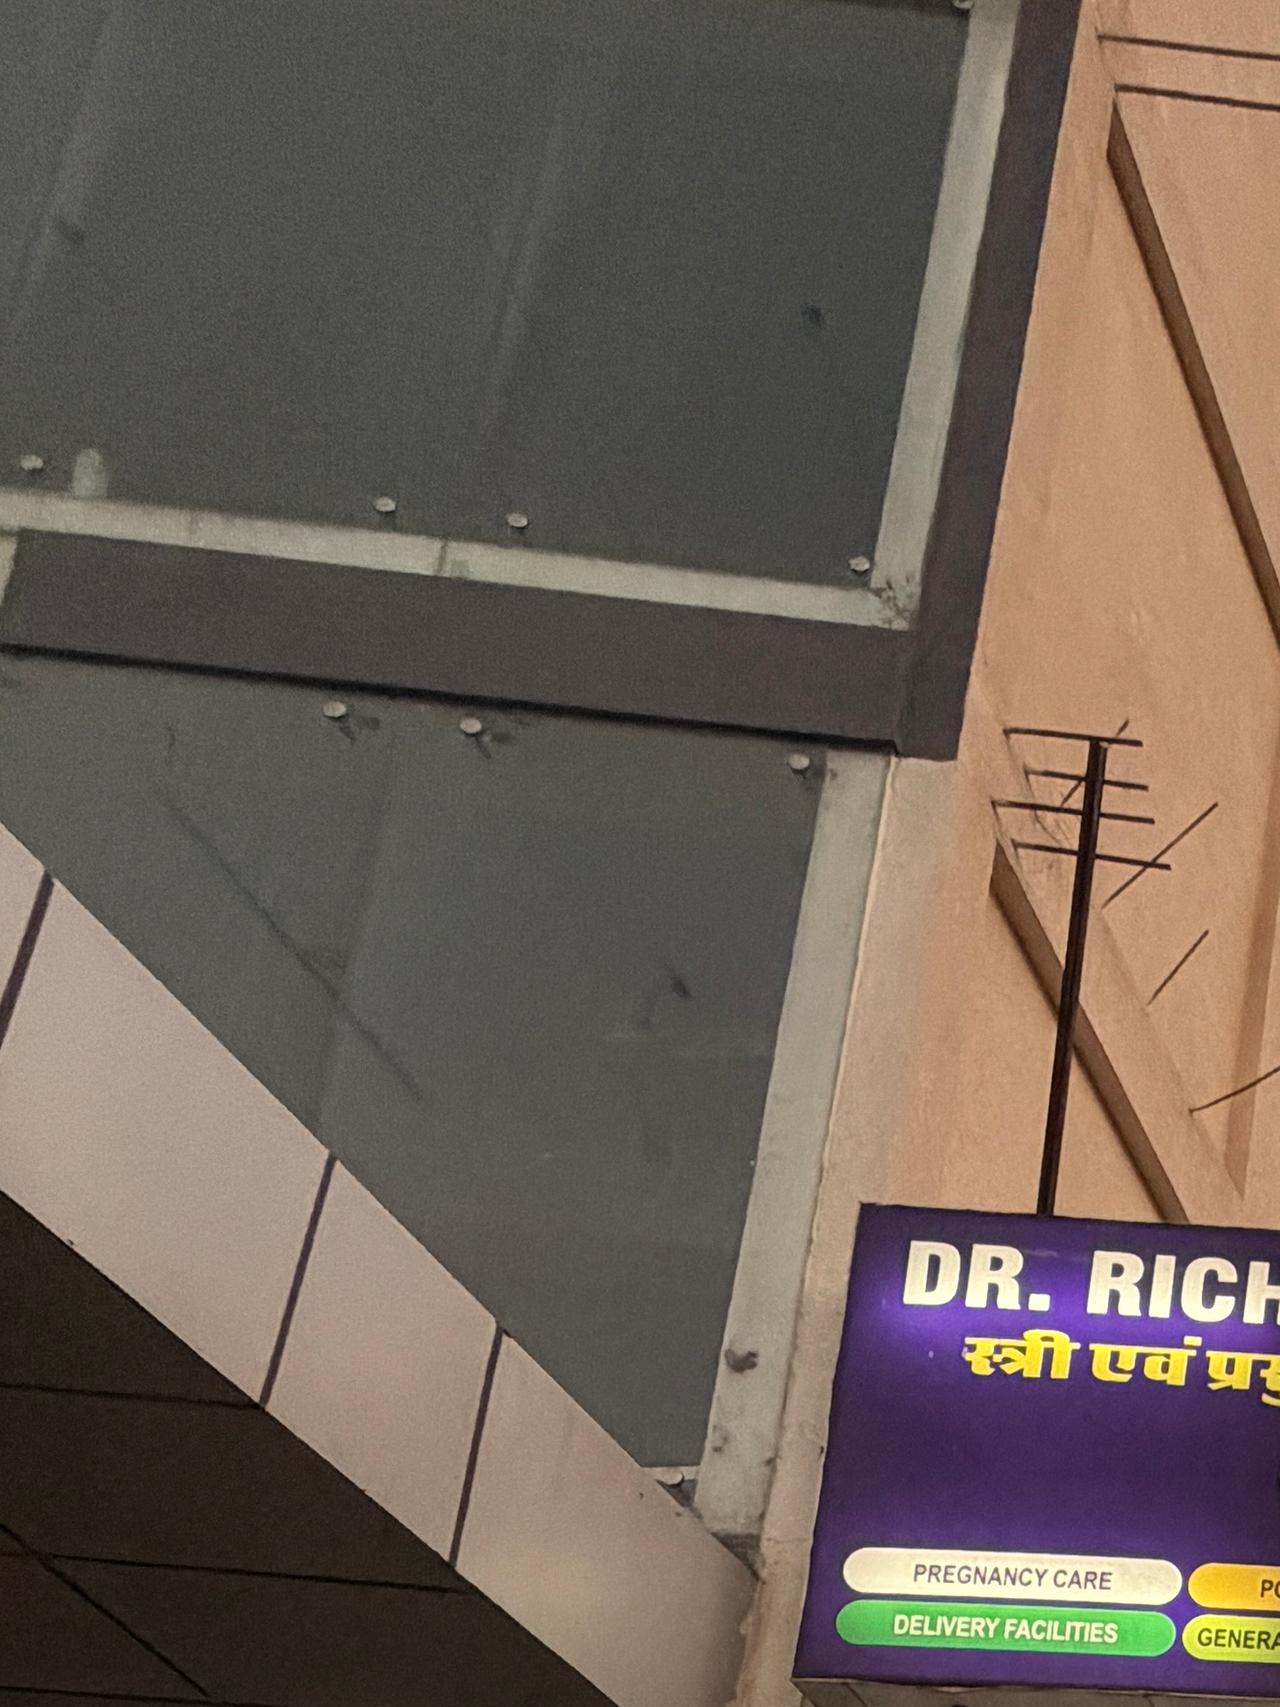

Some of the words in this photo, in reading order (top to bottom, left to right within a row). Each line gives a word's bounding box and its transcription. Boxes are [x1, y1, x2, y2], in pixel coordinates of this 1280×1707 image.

[903, 1240, 1051, 1312] DR.
[964, 1329, 1081, 1380] स्त्री
[1089, 1336, 1202, 1386] एवं
[913, 1564, 1048, 1589] PREGNANCY
[1053, 1569, 1112, 1591] CARE
[893, 1614, 1001, 1639] DELIVERY
[1003, 1618, 1119, 1644] FACILITIES
